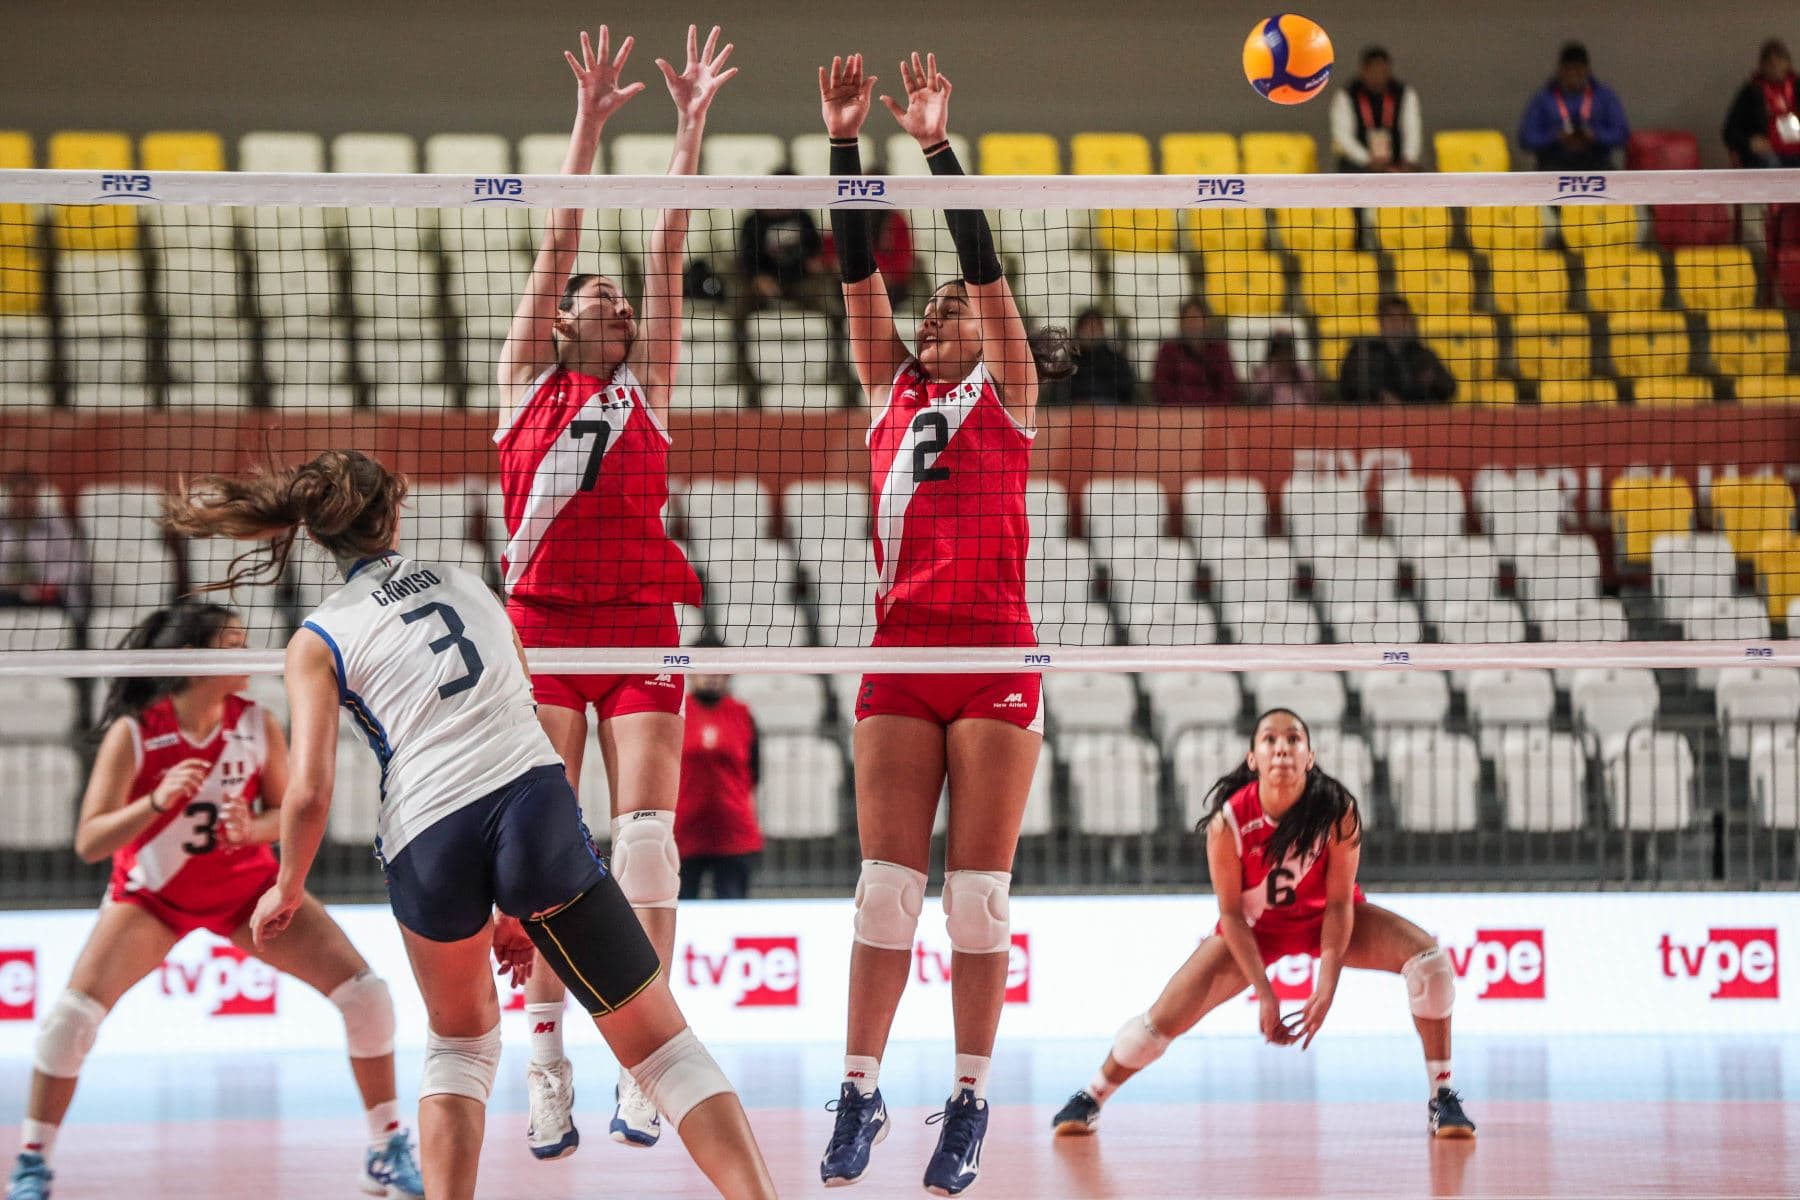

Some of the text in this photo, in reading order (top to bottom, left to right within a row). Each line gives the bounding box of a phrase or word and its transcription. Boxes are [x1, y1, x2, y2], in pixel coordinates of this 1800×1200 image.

[101, 174, 151, 191] FIVB
[474, 178, 522, 195] FIVB
[837, 180, 885, 196] FIVB
[1198, 179, 1245, 195] FIVB
[1558, 175, 1606, 192] FIVB
[569, 420, 612, 493] 7
[912, 411, 951, 483] 2
[399, 601, 485, 700] 3
[663, 655, 690, 665] FIVB
[1024, 655, 1051, 664] FIVB
[182, 802, 218, 856] 3
[1267, 867, 1297, 907] 6
[684, 937, 798, 1007] tvpe
[916, 934, 1029, 1003] tve
[1446, 929, 1545, 1000] vpe
[1657, 928, 1779, 1000] tvpe
